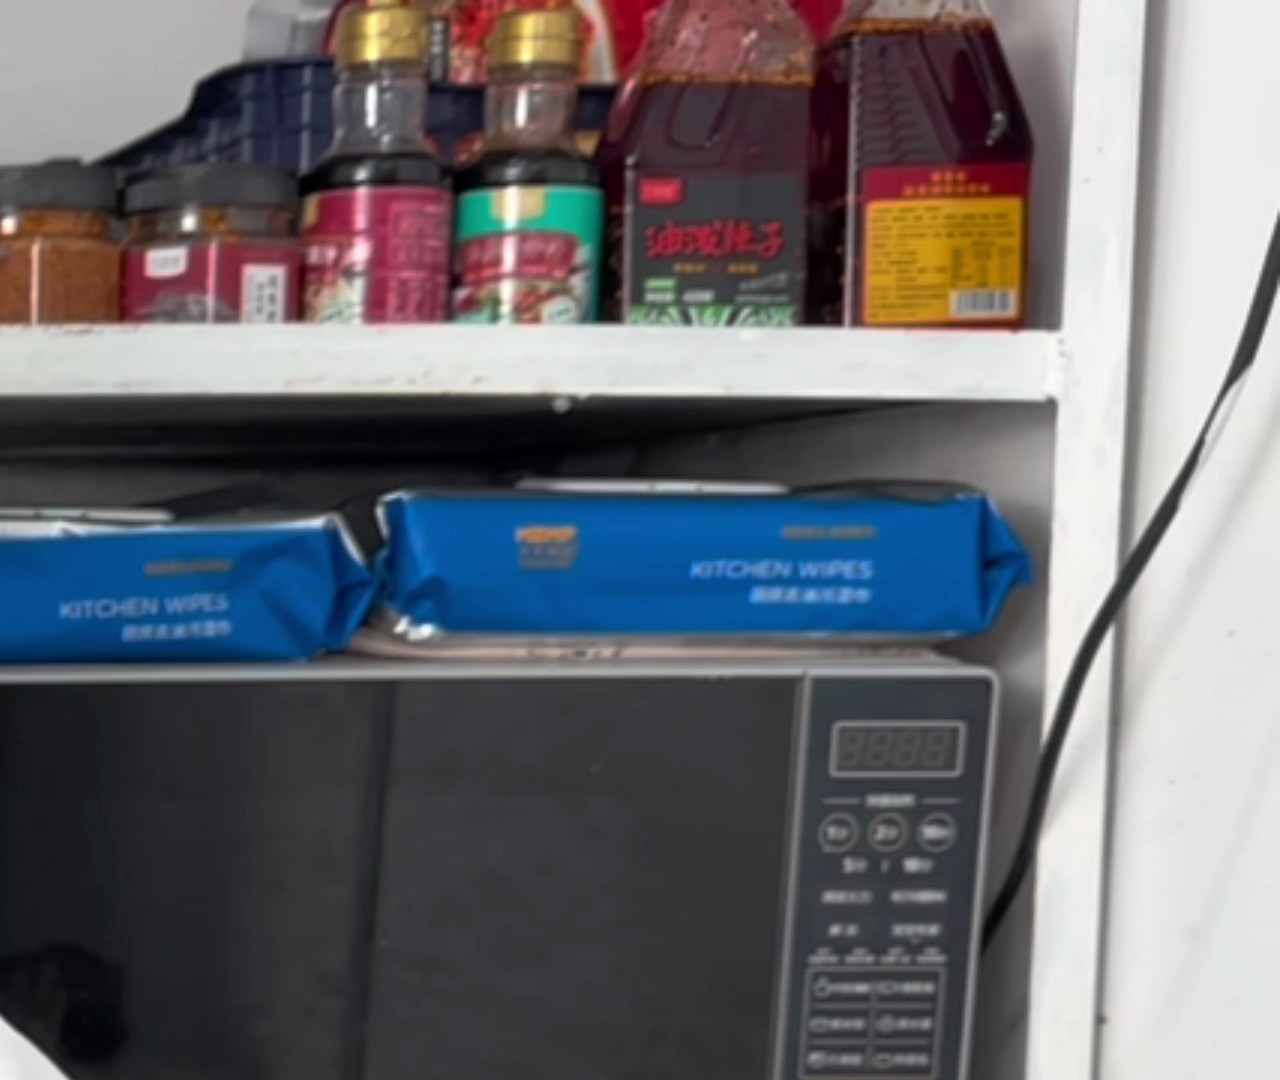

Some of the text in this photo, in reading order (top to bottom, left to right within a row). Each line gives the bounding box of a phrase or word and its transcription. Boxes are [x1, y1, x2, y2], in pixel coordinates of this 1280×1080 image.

[689, 559, 873, 580] KITCHEN WIPES
[59, 593, 229, 620] KITCHEN WIPES
